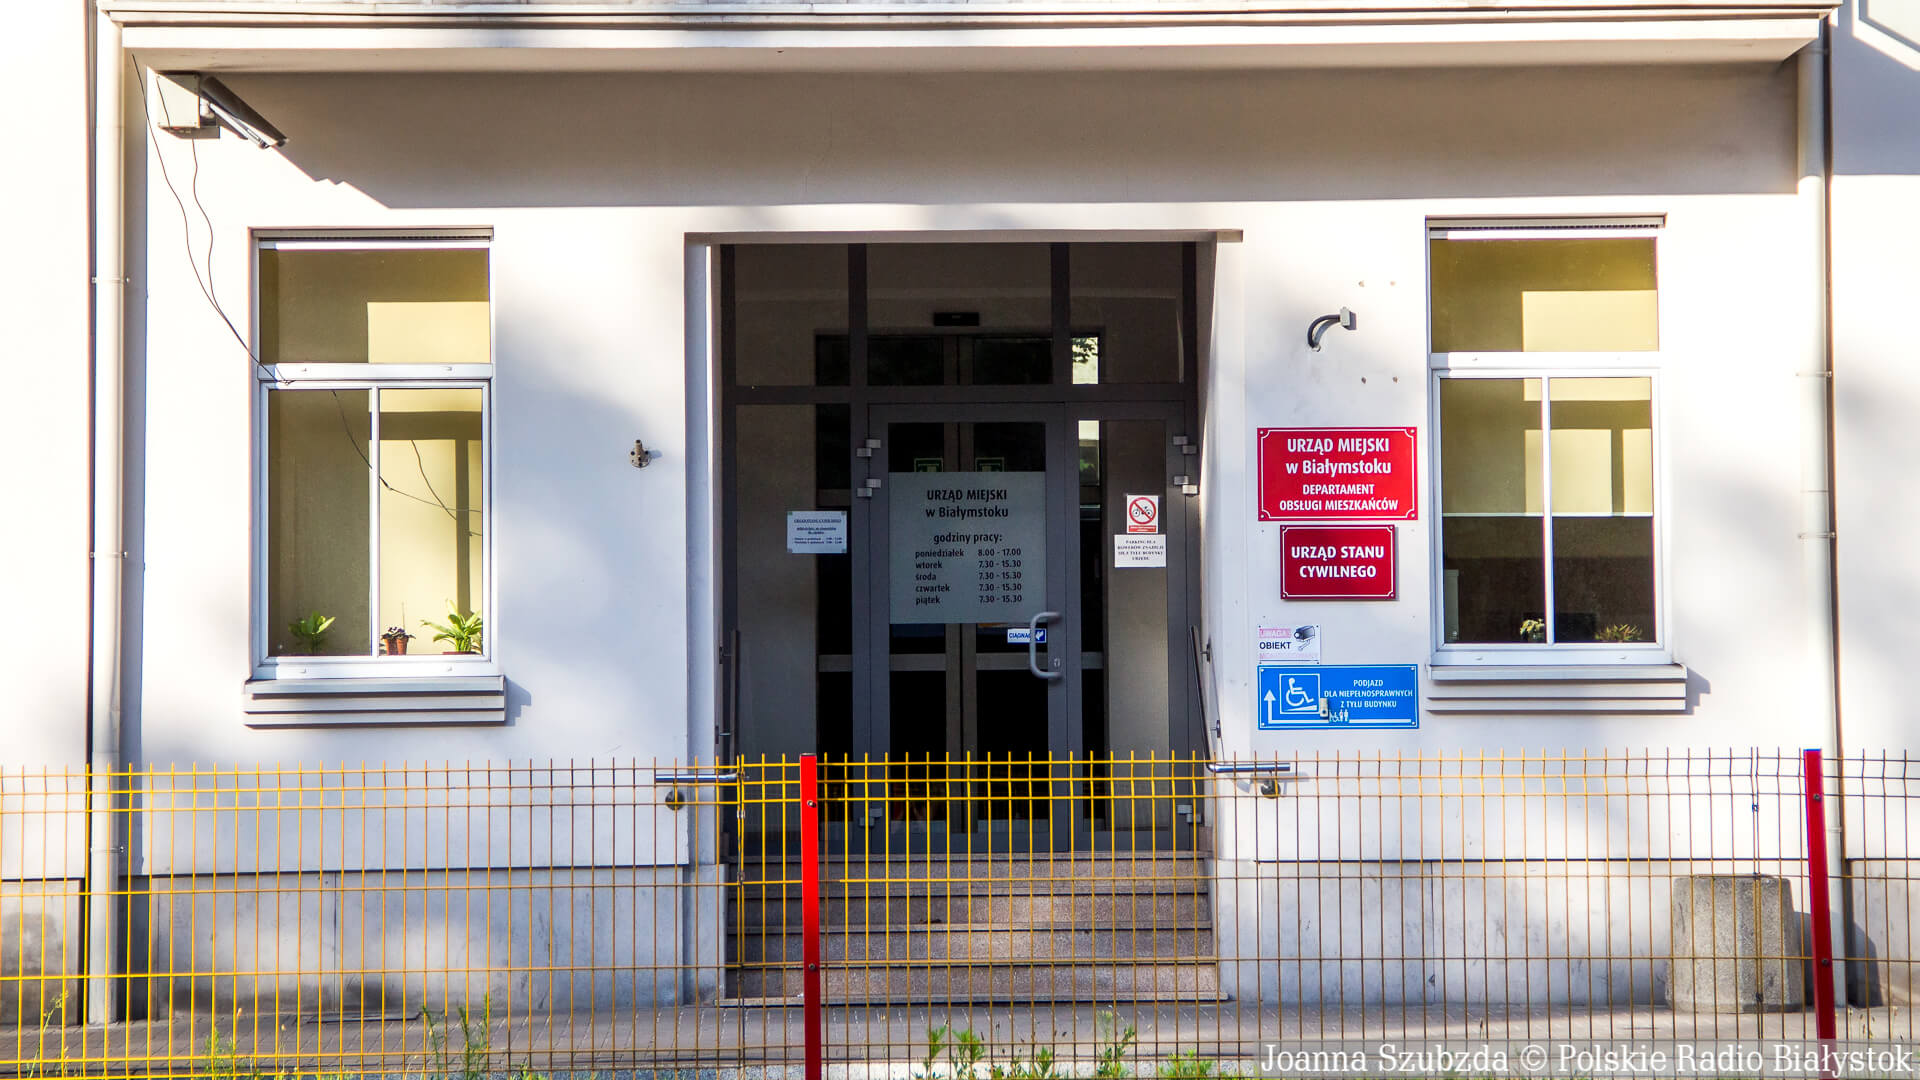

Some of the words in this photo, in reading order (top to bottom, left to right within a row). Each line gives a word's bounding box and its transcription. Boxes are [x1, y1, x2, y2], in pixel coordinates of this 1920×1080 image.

[1287, 438, 1333, 455] URZĄD
[1338, 438, 1389, 455] MIEJSKI
[1286, 462, 1298, 474] w
[1302, 458, 1391, 477] Białymstoku
[1302, 484, 1375, 495] DEPARTAMENT
[927, 489, 963, 503] URZĄD
[966, 489, 1007, 502] MIEJSKI
[1279, 500, 1322, 511] OBSŁUGI
[1325, 497, 1398, 511] MIESZKAŃCÓW
[926, 509, 935, 518] w
[939, 506, 1009, 520] Białymstoku
[933, 532, 970, 545] godziny
[973, 533, 1002, 544] pracy:
[915, 549, 964, 559] poniedziałek
[978, 549, 995, 557] 8.00
[1003, 548, 1021, 556] 17.00
[1291, 546, 1336, 561] URZĄD
[1340, 546, 1384, 558] STANU
[915, 561, 942, 569] wtorek
[978, 560, 994, 568] 7.30
[1002, 560, 1022, 568] 15.30
[915, 572, 937, 581] środa
[979, 572, 994, 580] 7.30
[1299, 565, 1377, 578] CYWILNEGO
[915, 584, 950, 592] czwartek
[1002, 583, 1022, 591] 15.30
[915, 596, 941, 606] piątek
[979, 595, 995, 603] 7.30
[1002, 595, 1022, 603] 15.30
[1259, 642, 1291, 650] OBIEKT
[1353, 679, 1384, 688] PODJAZD
[1324, 690, 1338, 698] DLA
[1339, 689, 1413, 698] NIEPEŁNOSPRAWNYCH
[1346, 700, 1363, 708] TYŁU
[1364, 700, 1397, 708] BUDYNKU
